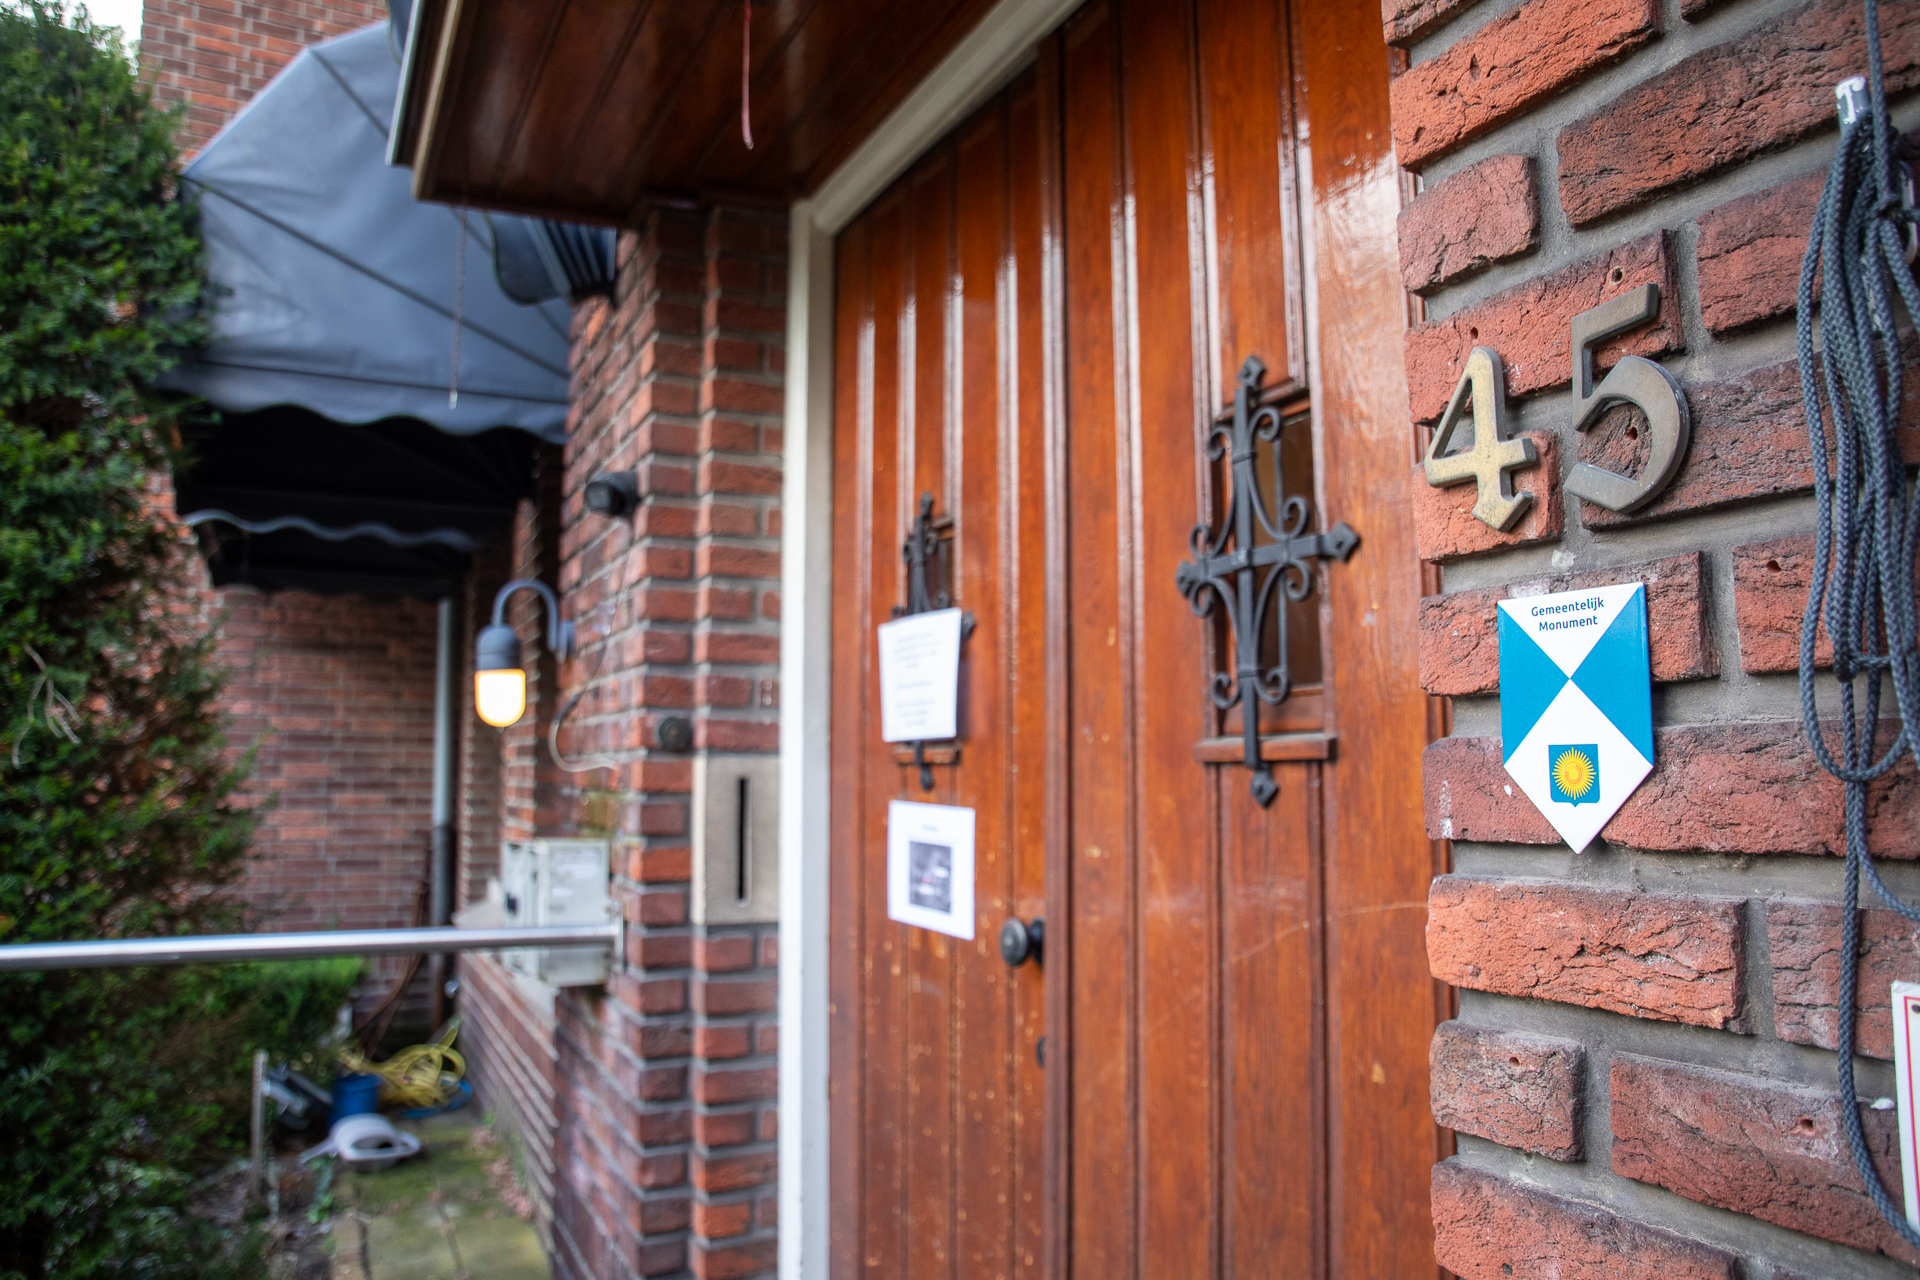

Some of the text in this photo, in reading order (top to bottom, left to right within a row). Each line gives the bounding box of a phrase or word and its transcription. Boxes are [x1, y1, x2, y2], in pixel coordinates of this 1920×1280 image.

[1424, 282, 1690, 532] 45
[1531, 597, 1604, 616] Gemeentelijk
[1539, 616, 1598, 631] Monument
